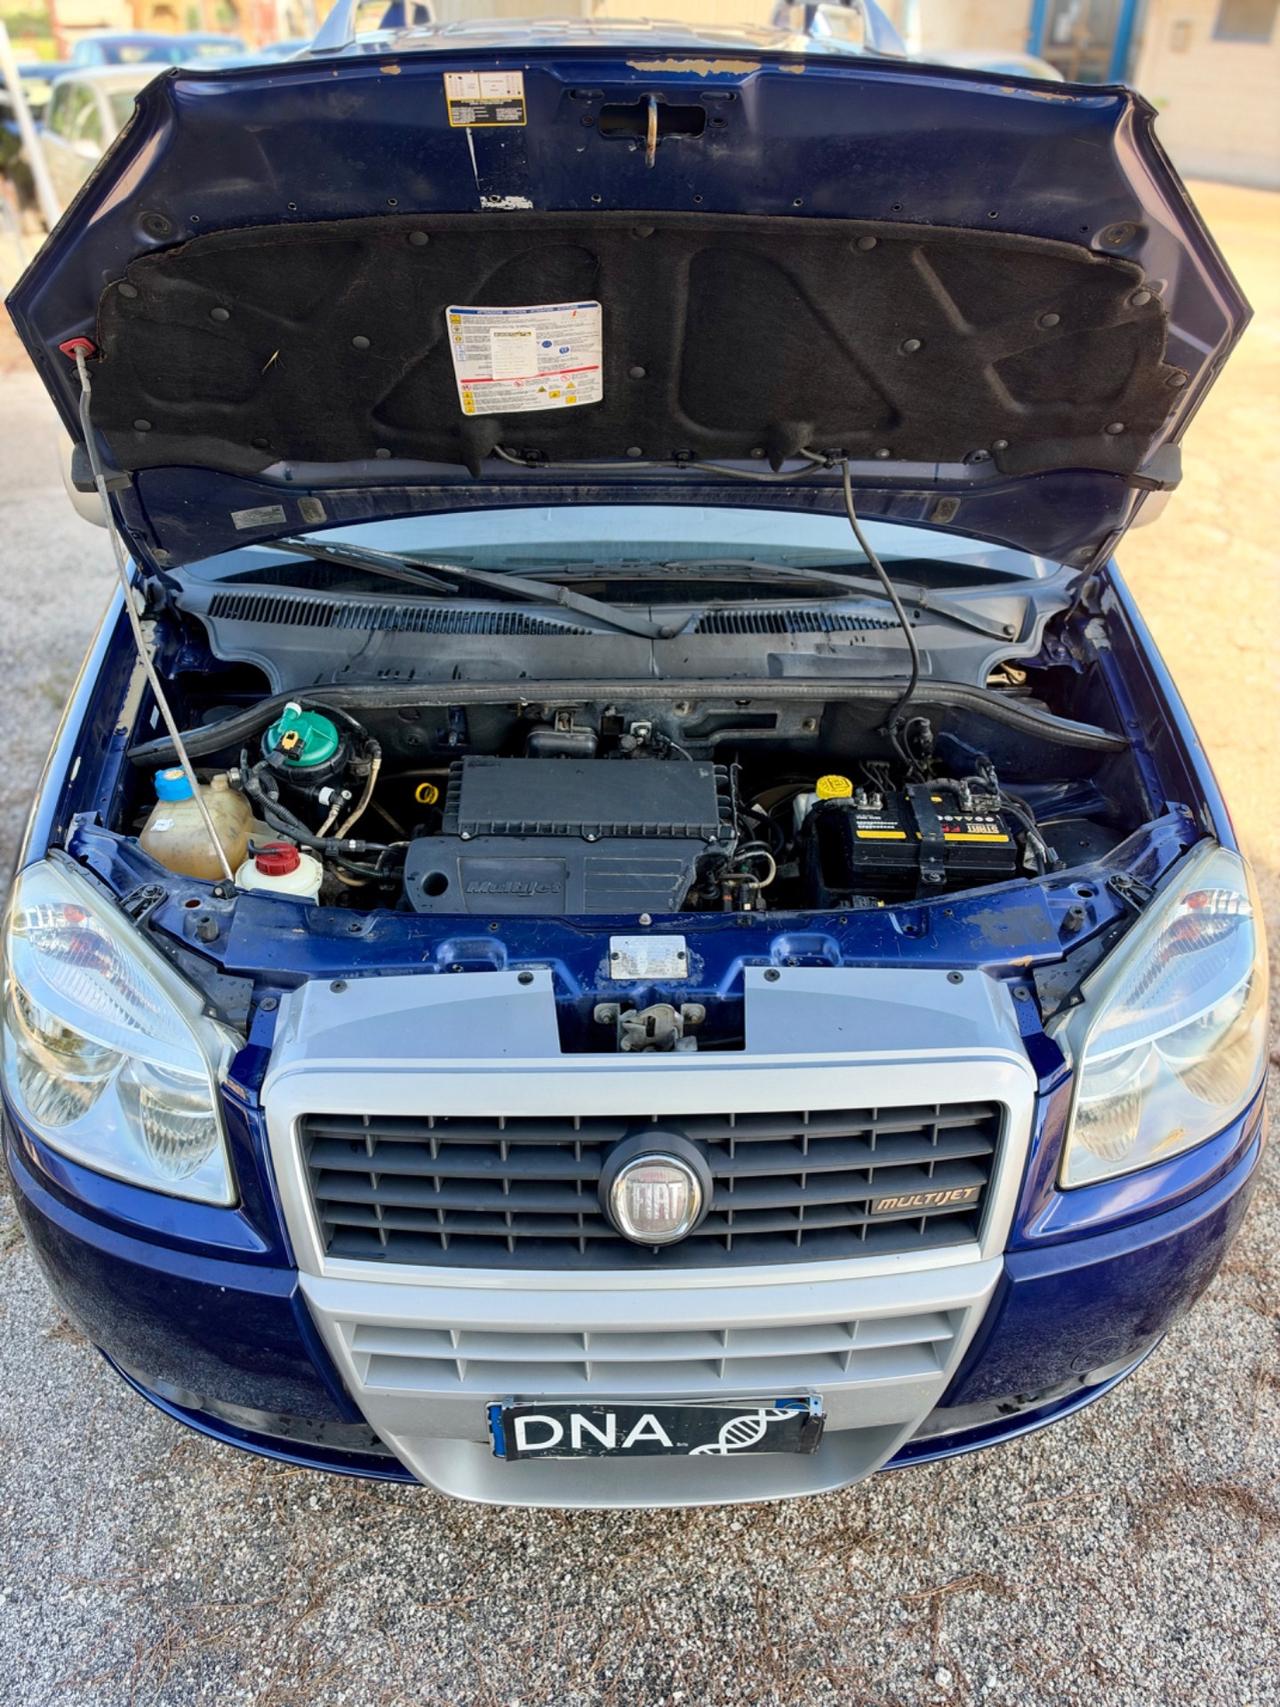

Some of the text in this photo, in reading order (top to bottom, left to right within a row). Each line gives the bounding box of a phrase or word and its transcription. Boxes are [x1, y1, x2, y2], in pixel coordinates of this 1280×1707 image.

[632, 1182, 682, 1220] FIAT
[877, 1187, 977, 1210] MULTIJET
[514, 1413, 673, 1451] DNA
